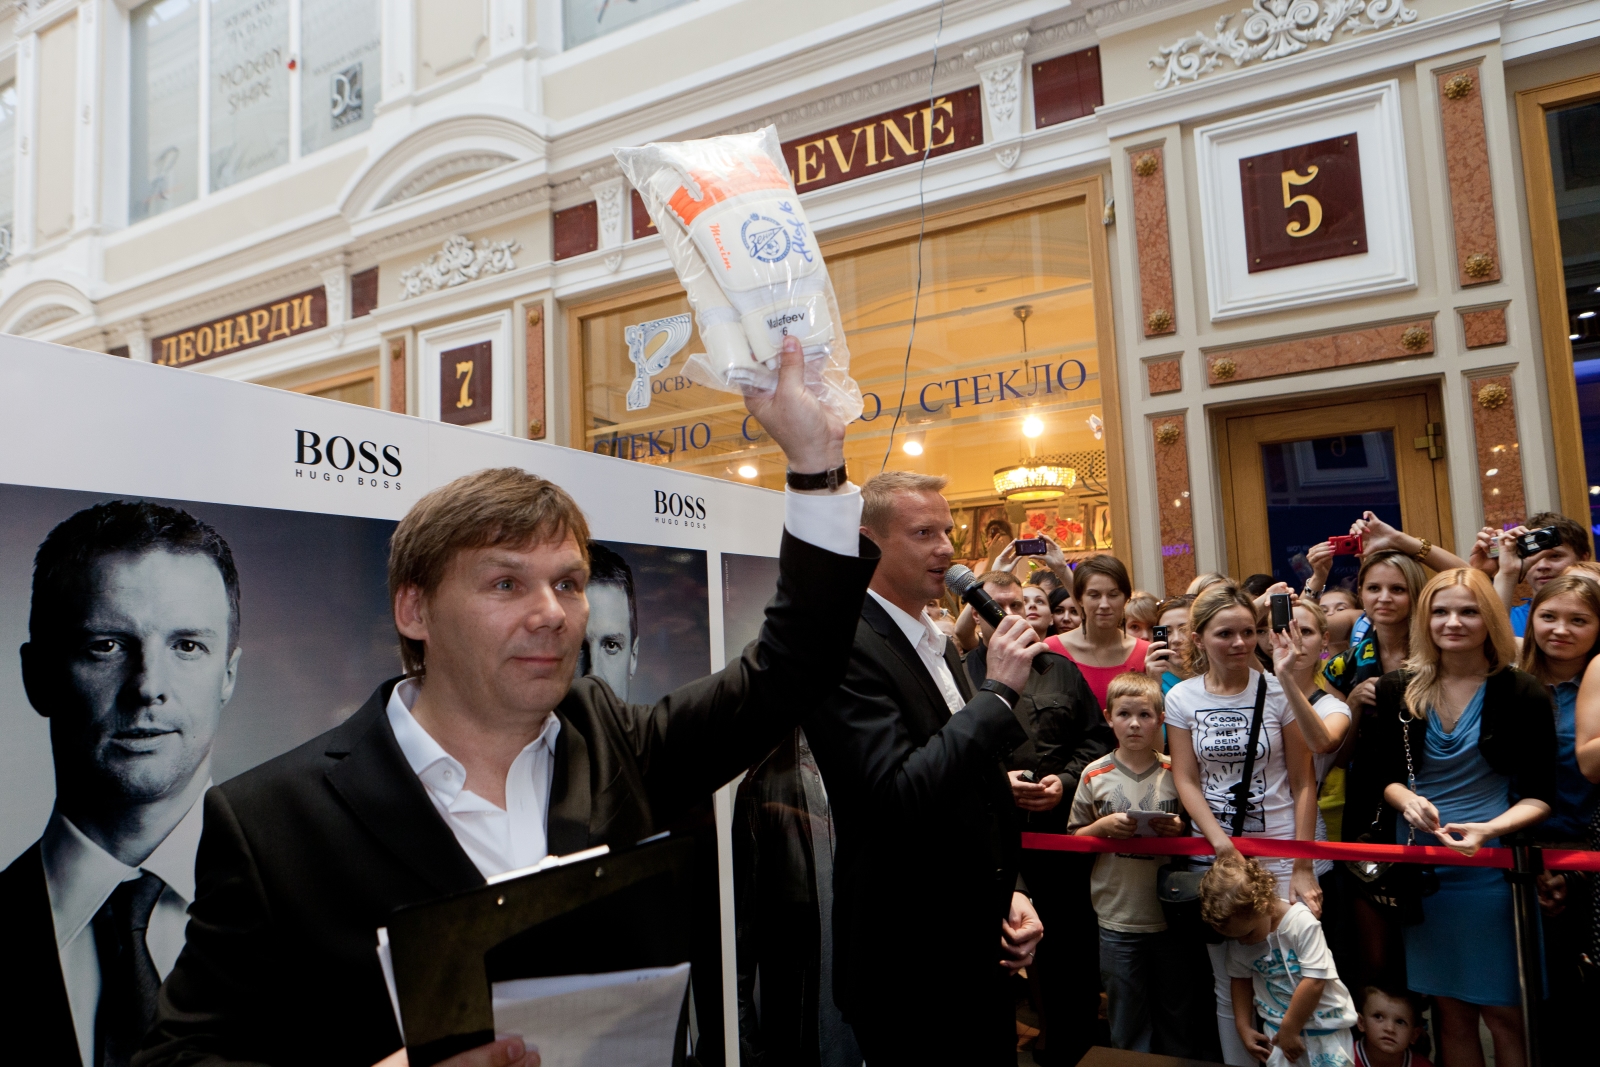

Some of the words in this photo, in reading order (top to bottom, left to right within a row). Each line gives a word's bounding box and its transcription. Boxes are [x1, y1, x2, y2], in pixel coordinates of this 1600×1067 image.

[790, 97, 955, 186] EVINÉ
[1281, 165, 1323, 238] 5
[709, 223, 732, 272] Maxim
[156, 295, 314, 366] ЛЕОНАРДИ
[455, 360, 475, 409] 7
[920, 359, 1087, 413] СТЕКЛО
[294, 429, 402, 478] BOSS
[295, 469, 344, 483] HUGO
[357, 477, 402, 491] BOSS
[654, 489, 707, 520] BOSS
[655, 516, 679, 526] HUGO
[684, 520, 707, 530] BOSS
[1216, 728, 1238, 736] ME!
